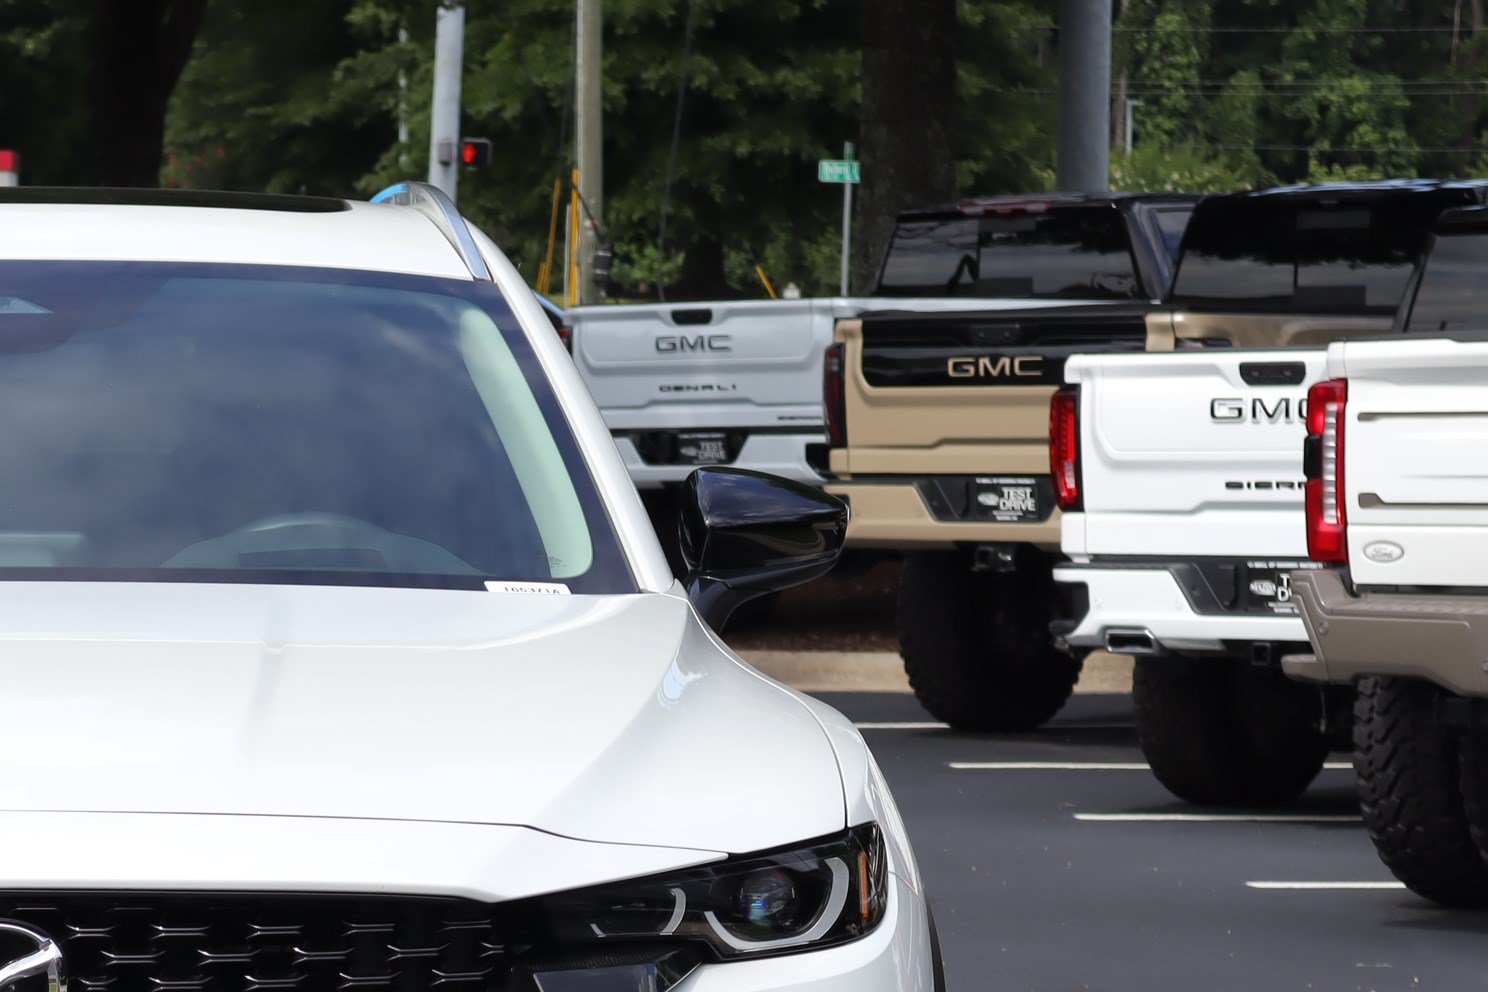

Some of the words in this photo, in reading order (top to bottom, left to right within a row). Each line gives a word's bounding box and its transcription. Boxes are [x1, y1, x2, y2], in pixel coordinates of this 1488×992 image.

[655, 335, 732, 351] GMC
[947, 355, 1043, 377] GMC
[659, 383, 736, 392] DENALI
[699, 441, 723, 450] TEST
[698, 449, 726, 460] DRIVE
[1001, 487, 1032, 500] TEST
[999, 498, 1036, 511] DRIVE
